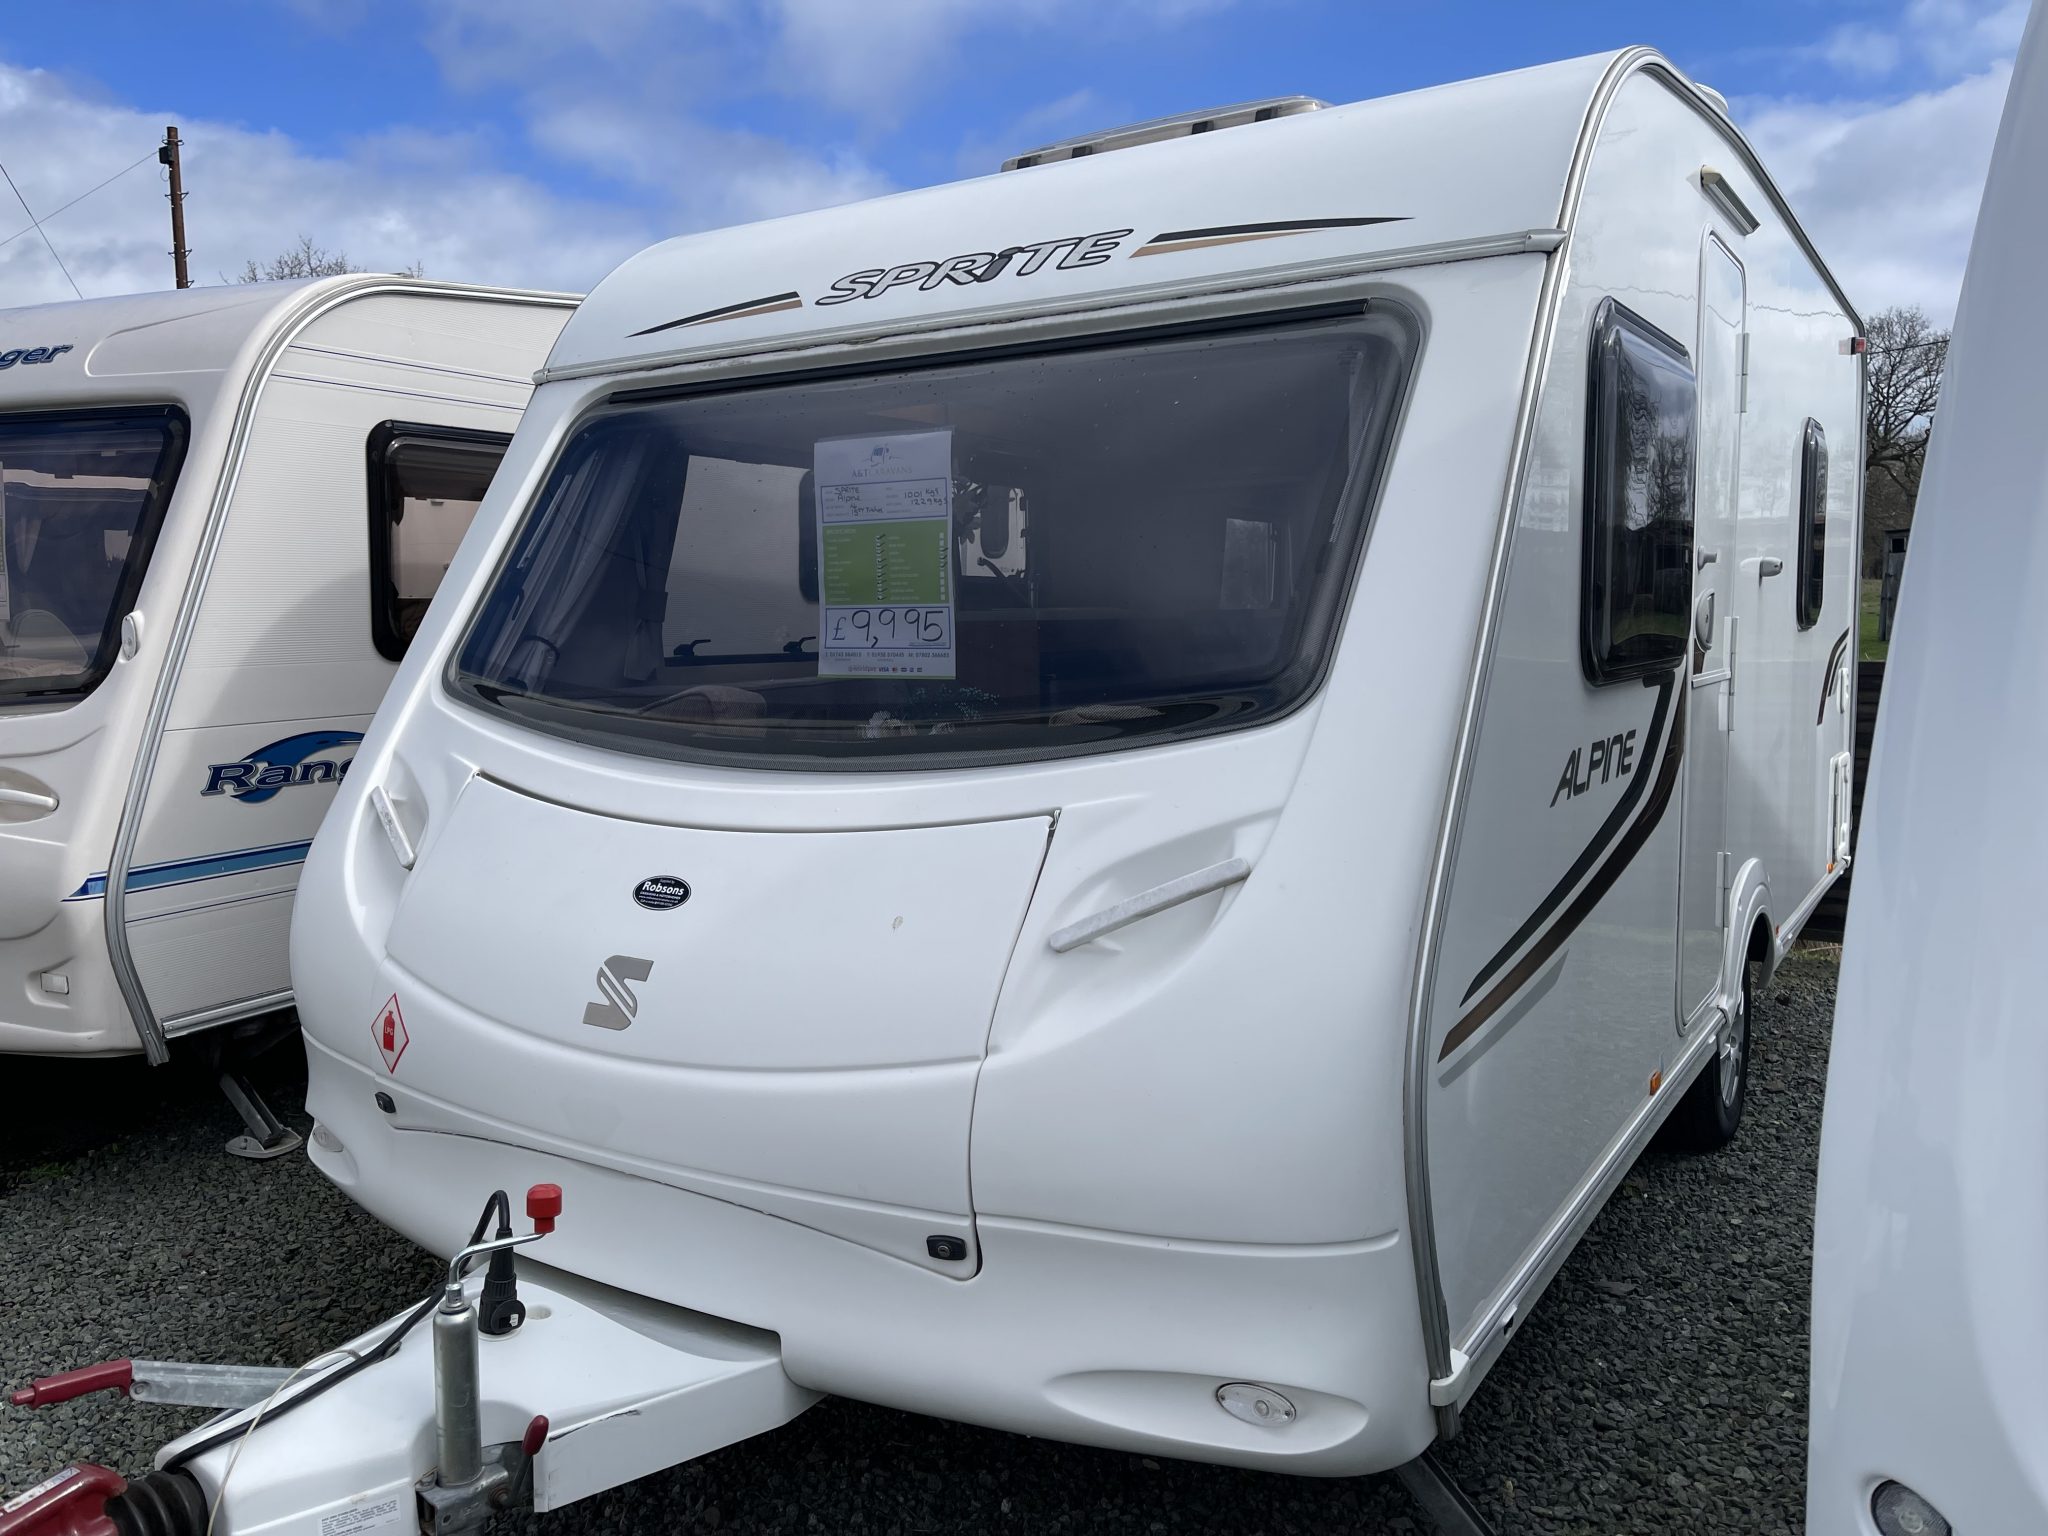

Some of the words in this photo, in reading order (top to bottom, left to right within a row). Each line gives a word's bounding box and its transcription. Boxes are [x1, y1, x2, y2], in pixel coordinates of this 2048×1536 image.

[814, 228, 1135, 306] SPRITE
[0, 344, 74, 370] ger
[832, 608, 944, 649] £9,995
[1550, 728, 1636, 808] ALPINE
[642, 881, 685, 896] Robsons
[384, 1025, 394, 1036] LPG
